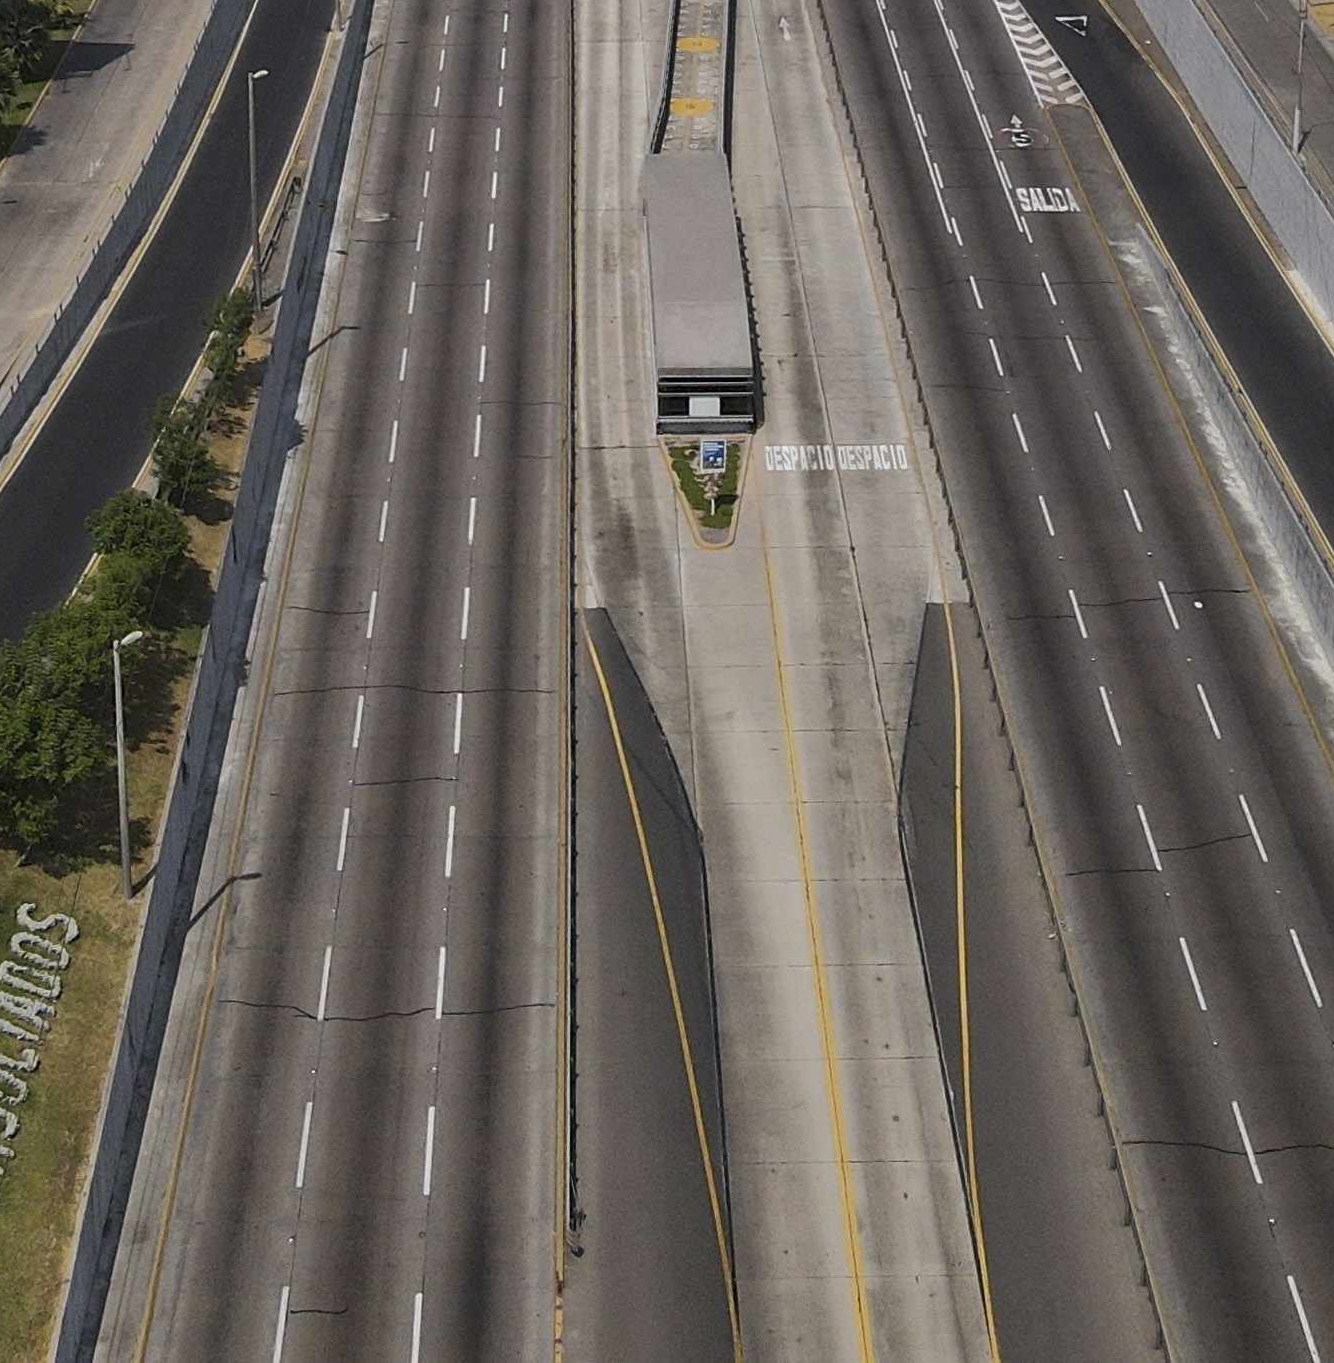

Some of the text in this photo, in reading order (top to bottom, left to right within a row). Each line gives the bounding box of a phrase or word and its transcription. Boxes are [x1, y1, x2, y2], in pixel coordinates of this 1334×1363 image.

[1016, 187, 1081, 213] SALIDA
[764, 444, 908, 472] DESPACIO DESPACIO
